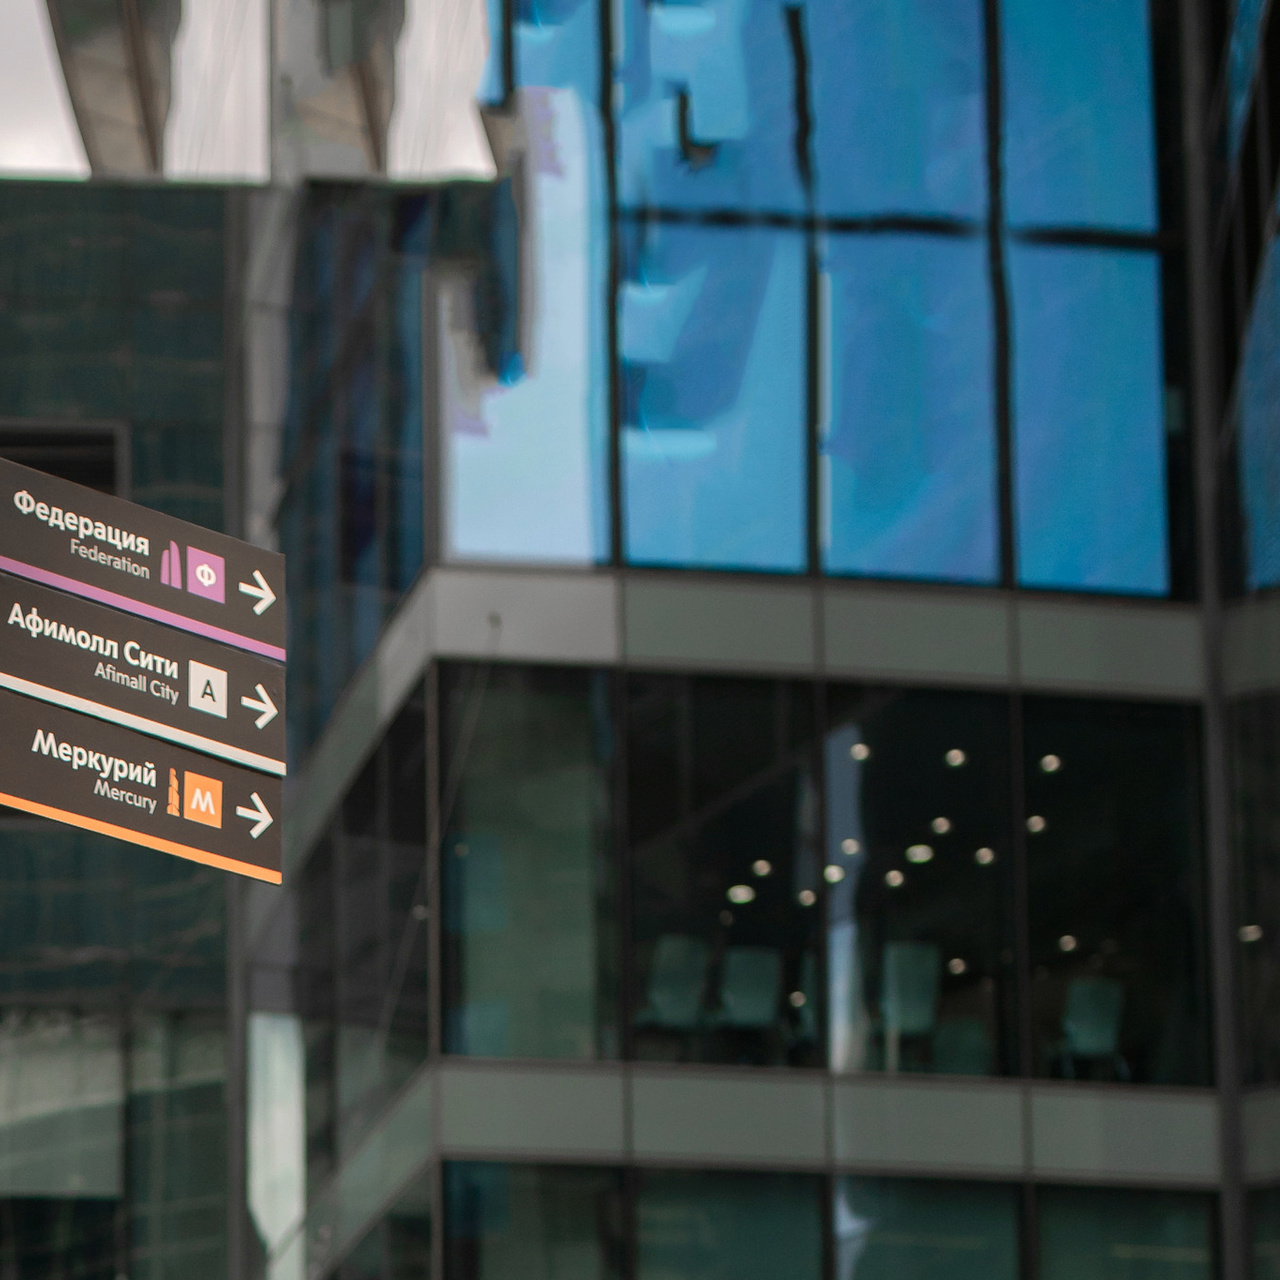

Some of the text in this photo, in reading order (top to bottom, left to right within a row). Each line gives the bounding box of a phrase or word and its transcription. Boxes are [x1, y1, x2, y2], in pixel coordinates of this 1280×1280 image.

[13, 489, 150, 556] Федерация
[70, 539, 150, 580] Federation
[196, 563, 216, 587] Ф
[7, 602, 178, 680] Афимолл Сити
[94, 662, 179, 705] Afimall City
[31, 729, 157, 787] Меркурий
[93, 778, 157, 815] Mercury
